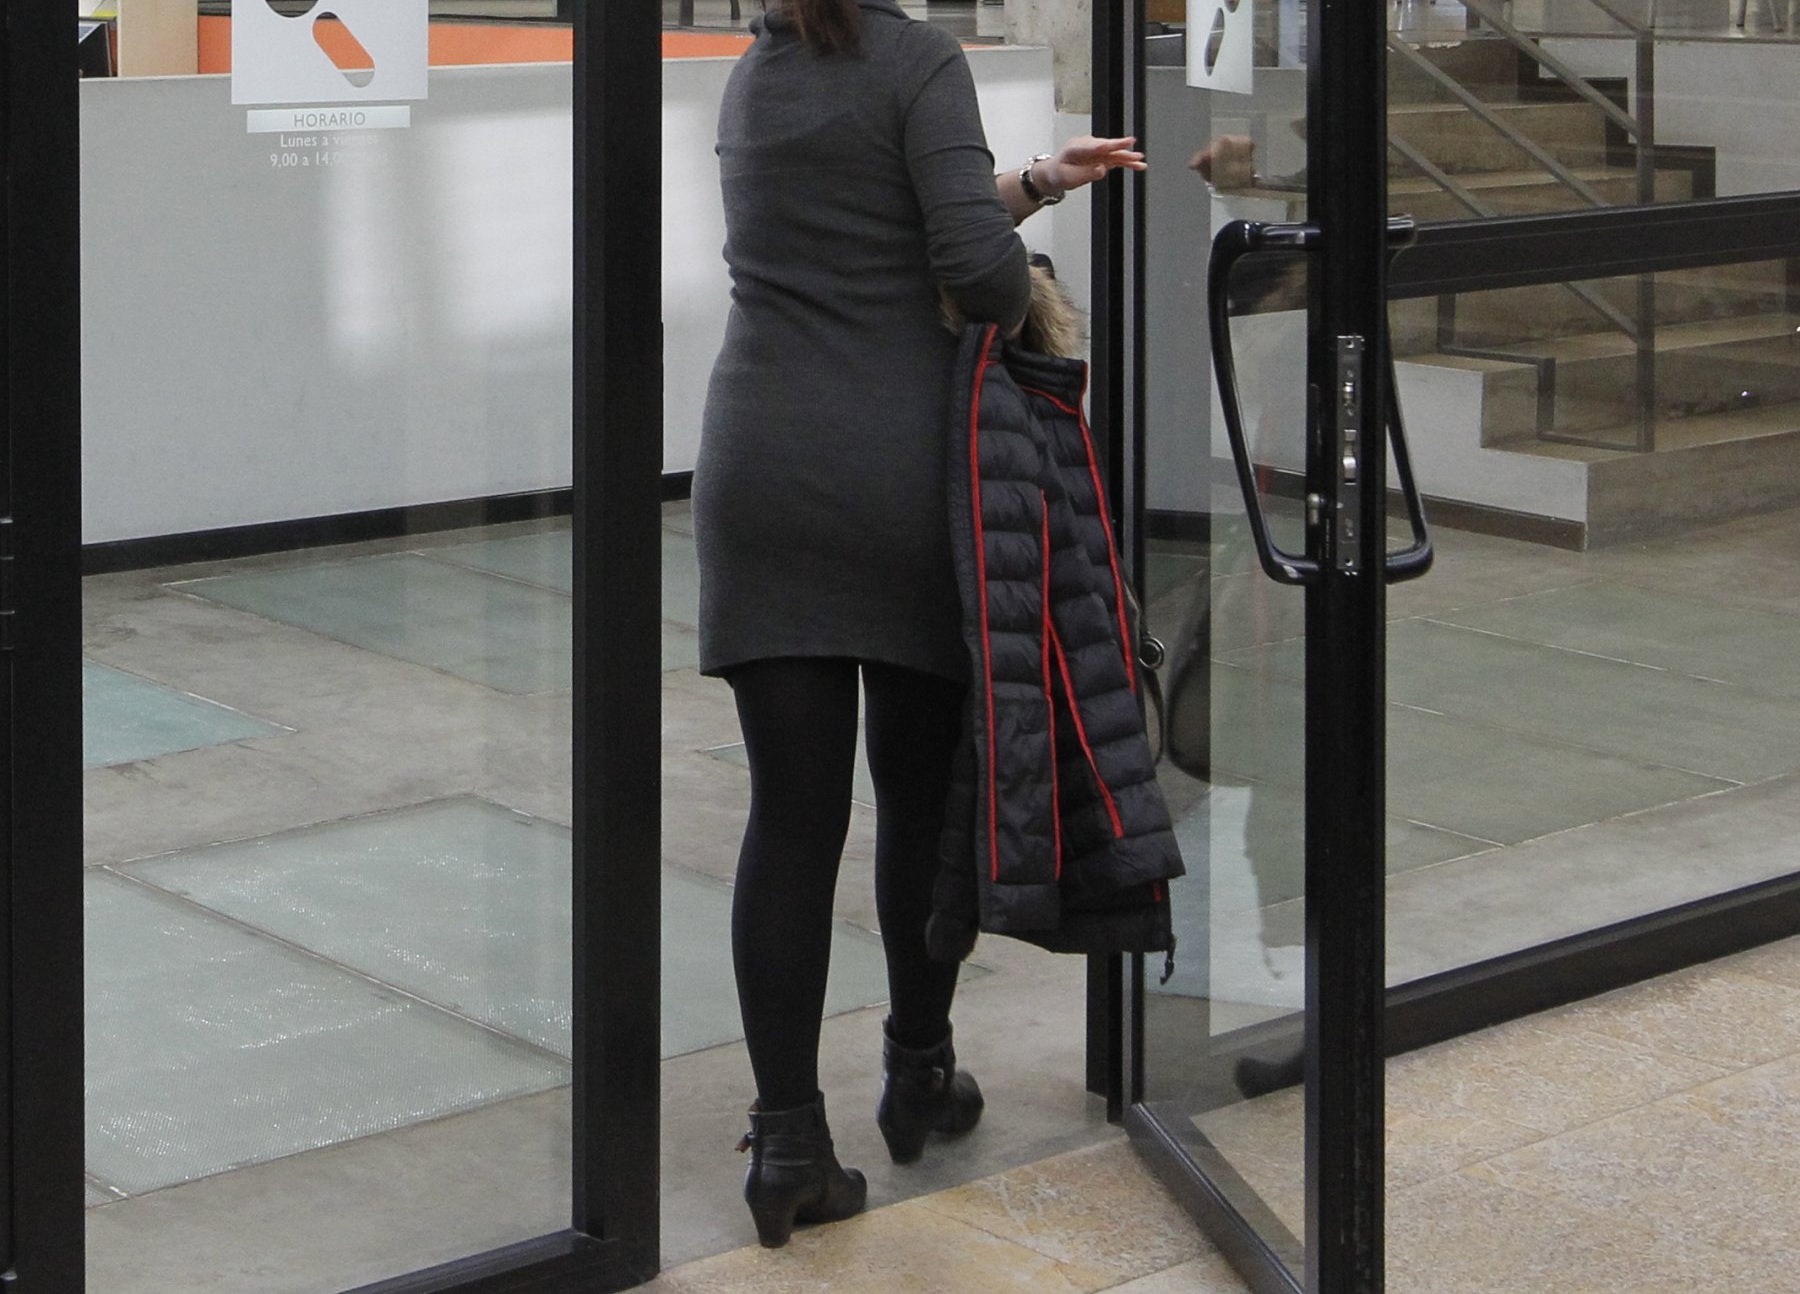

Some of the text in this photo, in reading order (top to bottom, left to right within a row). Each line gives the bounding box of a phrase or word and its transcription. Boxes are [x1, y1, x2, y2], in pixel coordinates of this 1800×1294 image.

[293, 111, 366, 127] HORARIO
[280, 133, 318, 148] Lunes
[321, 136, 329, 147] a
[270, 152, 298, 169] 9,00
[302, 156, 310, 167] a
